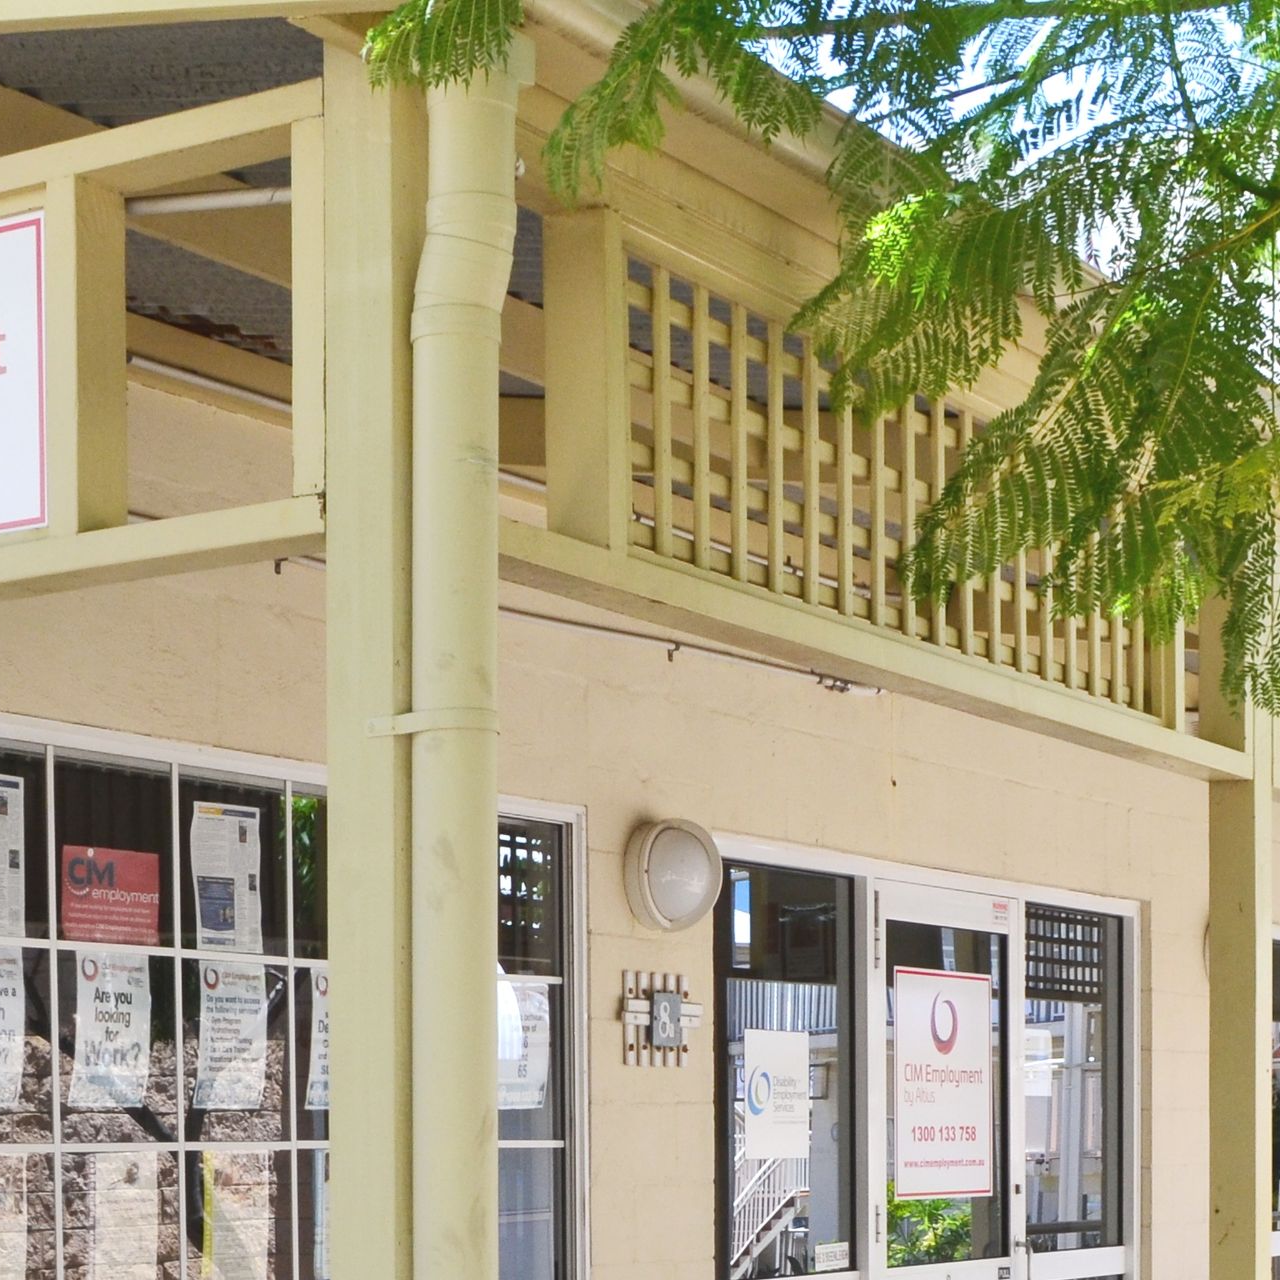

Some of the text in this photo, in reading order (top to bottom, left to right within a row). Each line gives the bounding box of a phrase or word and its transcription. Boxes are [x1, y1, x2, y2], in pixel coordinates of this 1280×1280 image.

[92, 888, 159, 904] employment
[11, 988, 17, 997] a
[94, 987, 133, 1010] Are you
[95, 1007, 131, 1028] looking
[105, 1027, 119, 1042] for
[84, 1040, 141, 1068] Work?
[904, 1063, 983, 1088] CIM Employment
[911, 1126, 977, 1141] 1300 133 758
